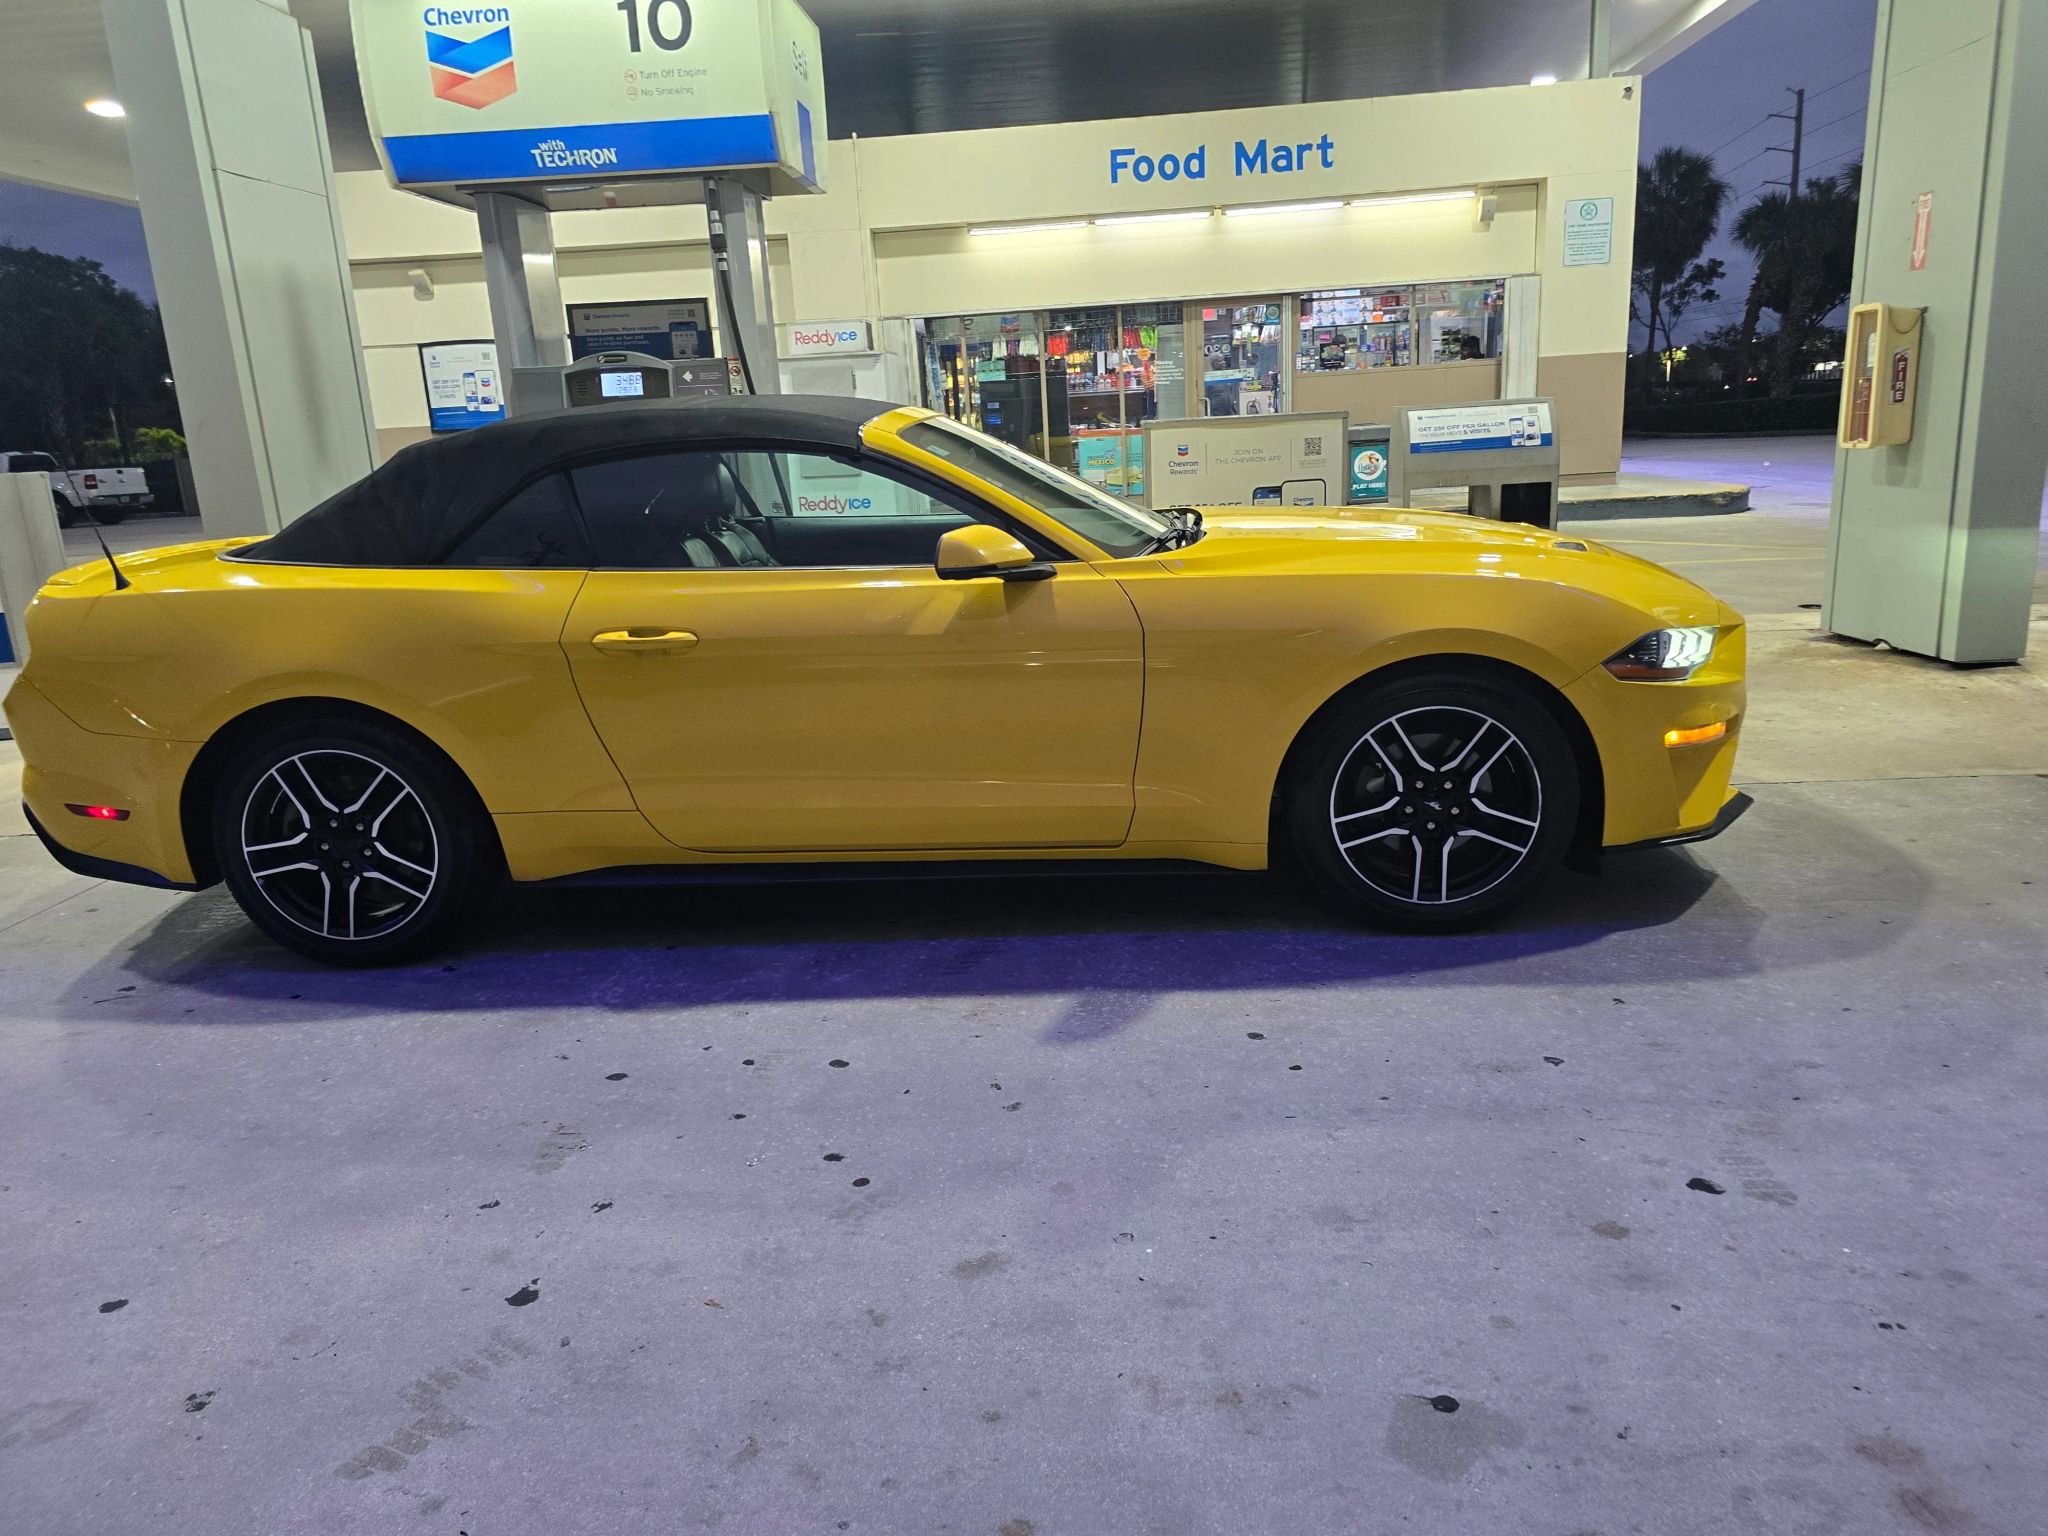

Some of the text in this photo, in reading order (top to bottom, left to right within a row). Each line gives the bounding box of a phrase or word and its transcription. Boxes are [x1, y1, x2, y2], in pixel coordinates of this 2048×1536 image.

[423, 7, 510, 27] Chevron
[616, 0, 693, 53] 10
[640, 67, 708, 80] Turn Off Engine
[640, 86, 694, 97] No Smoking
[537, 139, 566, 152] with
[530, 147, 618, 169] TECHRON
[1110, 133, 1334, 184] Food Mart
[1895, 361, 1906, 400] FIRE
[1462, 422, 1476, 430] PER
[1476, 421, 1506, 429] GALLON
[1469, 427, 1491, 435] VISITS
[1168, 460, 1199, 468] Chevron
[1215, 457, 1229, 465] THE
[1230, 456, 1266, 464] CHEVRON
